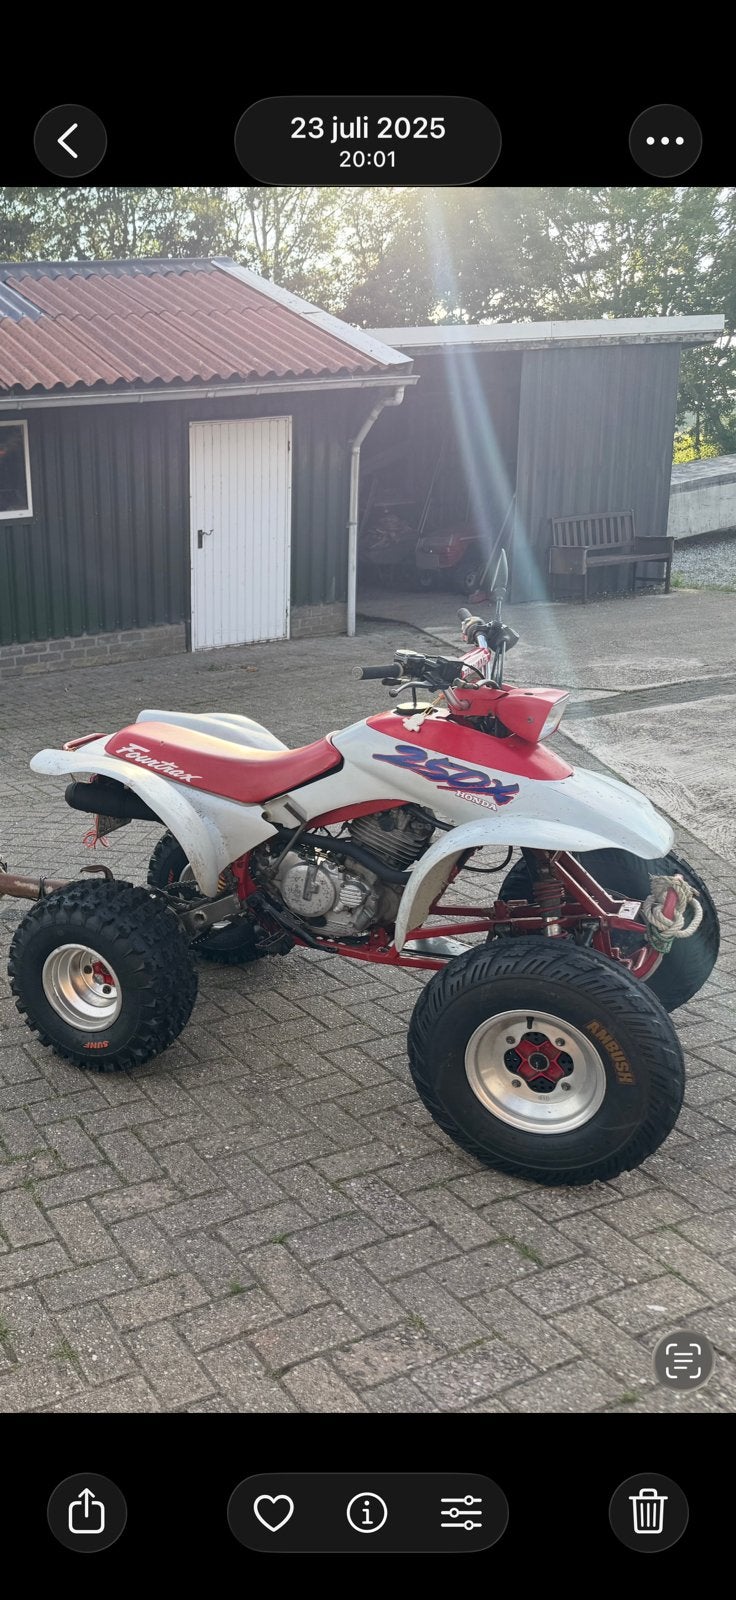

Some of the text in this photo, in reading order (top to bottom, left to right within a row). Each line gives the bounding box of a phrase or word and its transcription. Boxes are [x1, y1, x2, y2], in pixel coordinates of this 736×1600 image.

[116, 743, 203, 783] Fourtrax
[455, 790, 497, 812] HONDA
[82, 1040, 110, 1049] SUNF
[585, 1020, 635, 1085] AMBUSH
